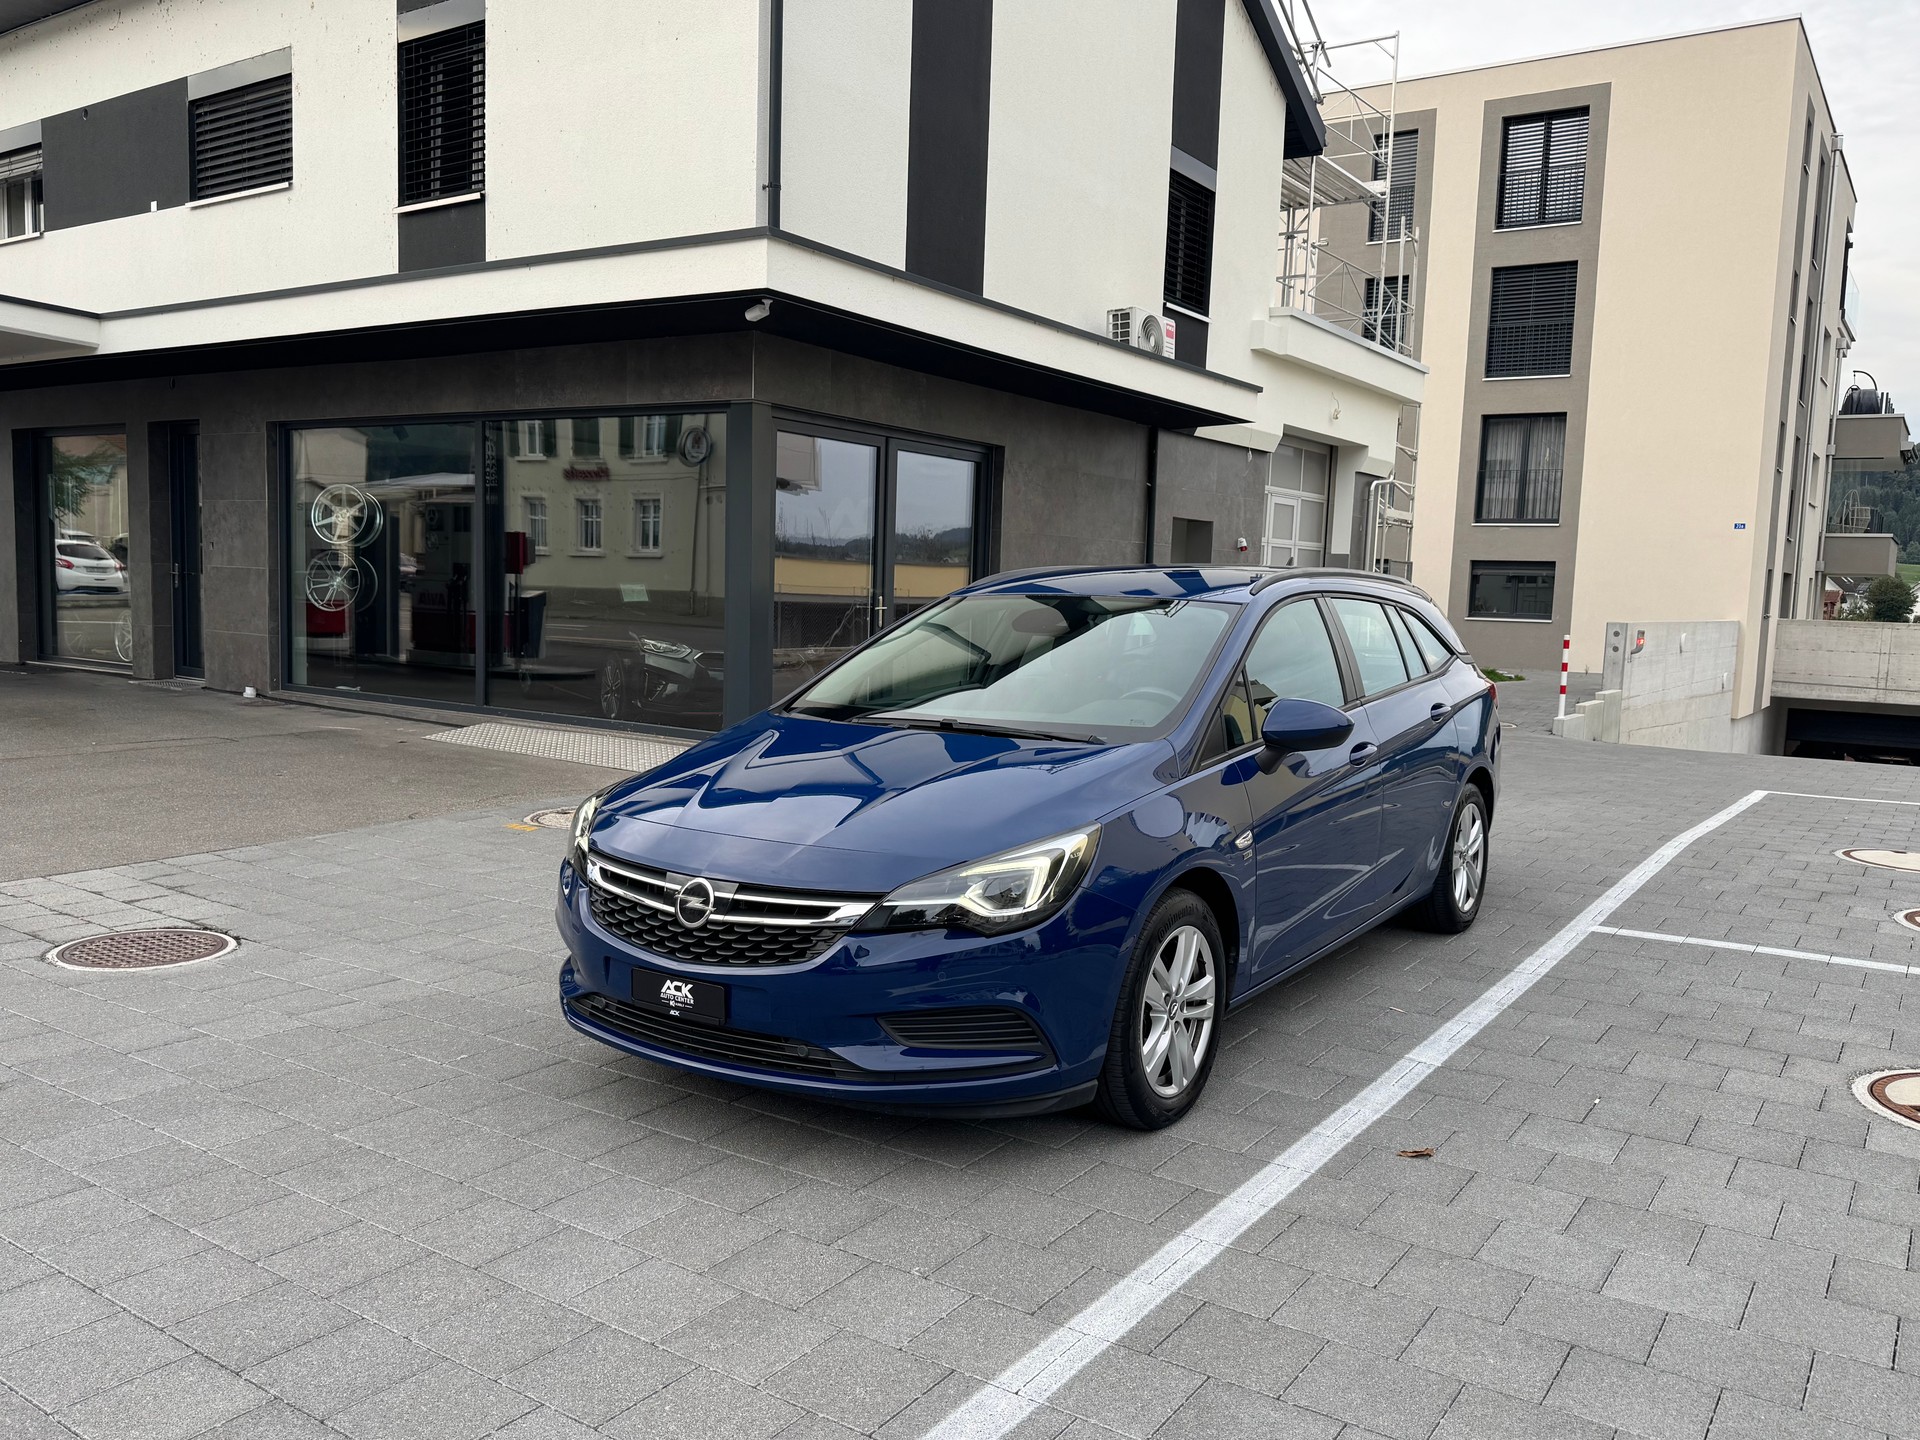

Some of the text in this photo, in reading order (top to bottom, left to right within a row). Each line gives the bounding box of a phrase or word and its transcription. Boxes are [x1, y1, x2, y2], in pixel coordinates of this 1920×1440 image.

[1158, 903, 1195, 943] Continental
[660, 979, 694, 999] ACK
[660, 992, 674, 1000] AUTO
[675, 995, 695, 1005] CENTER
[669, 1009, 680, 1017] ACK
